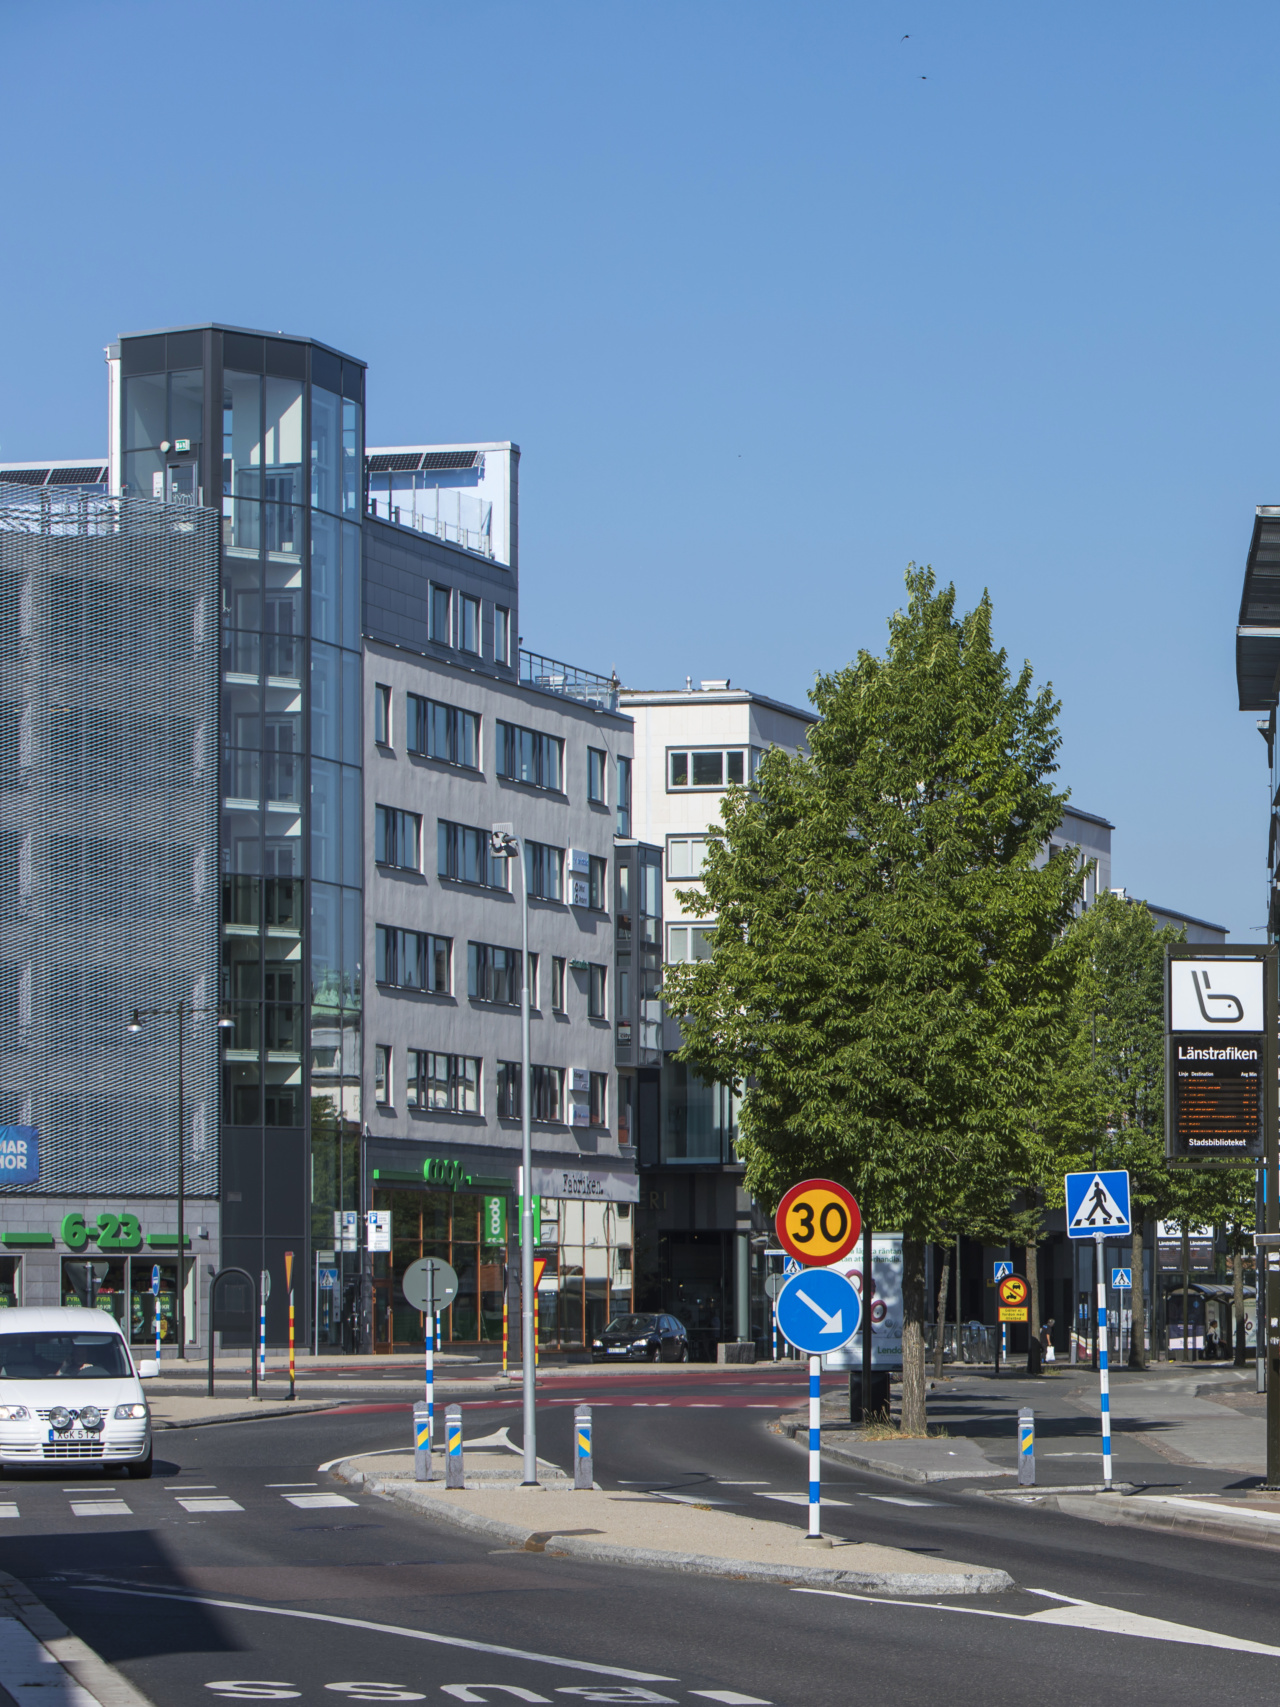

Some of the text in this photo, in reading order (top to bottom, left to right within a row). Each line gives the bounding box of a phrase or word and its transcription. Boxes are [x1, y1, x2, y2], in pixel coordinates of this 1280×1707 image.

[1178, 1046, 1258, 1060] Länstrafiken
[424, 1158, 464, 1192] coop
[61, 1213, 141, 1247] 6-23
[792, 1202, 848, 1243] 30
[878, 1346, 902, 1354] Lendo
[78, 1430, 96, 1439] 512
[204, 1681, 679, 1705] BUSS
